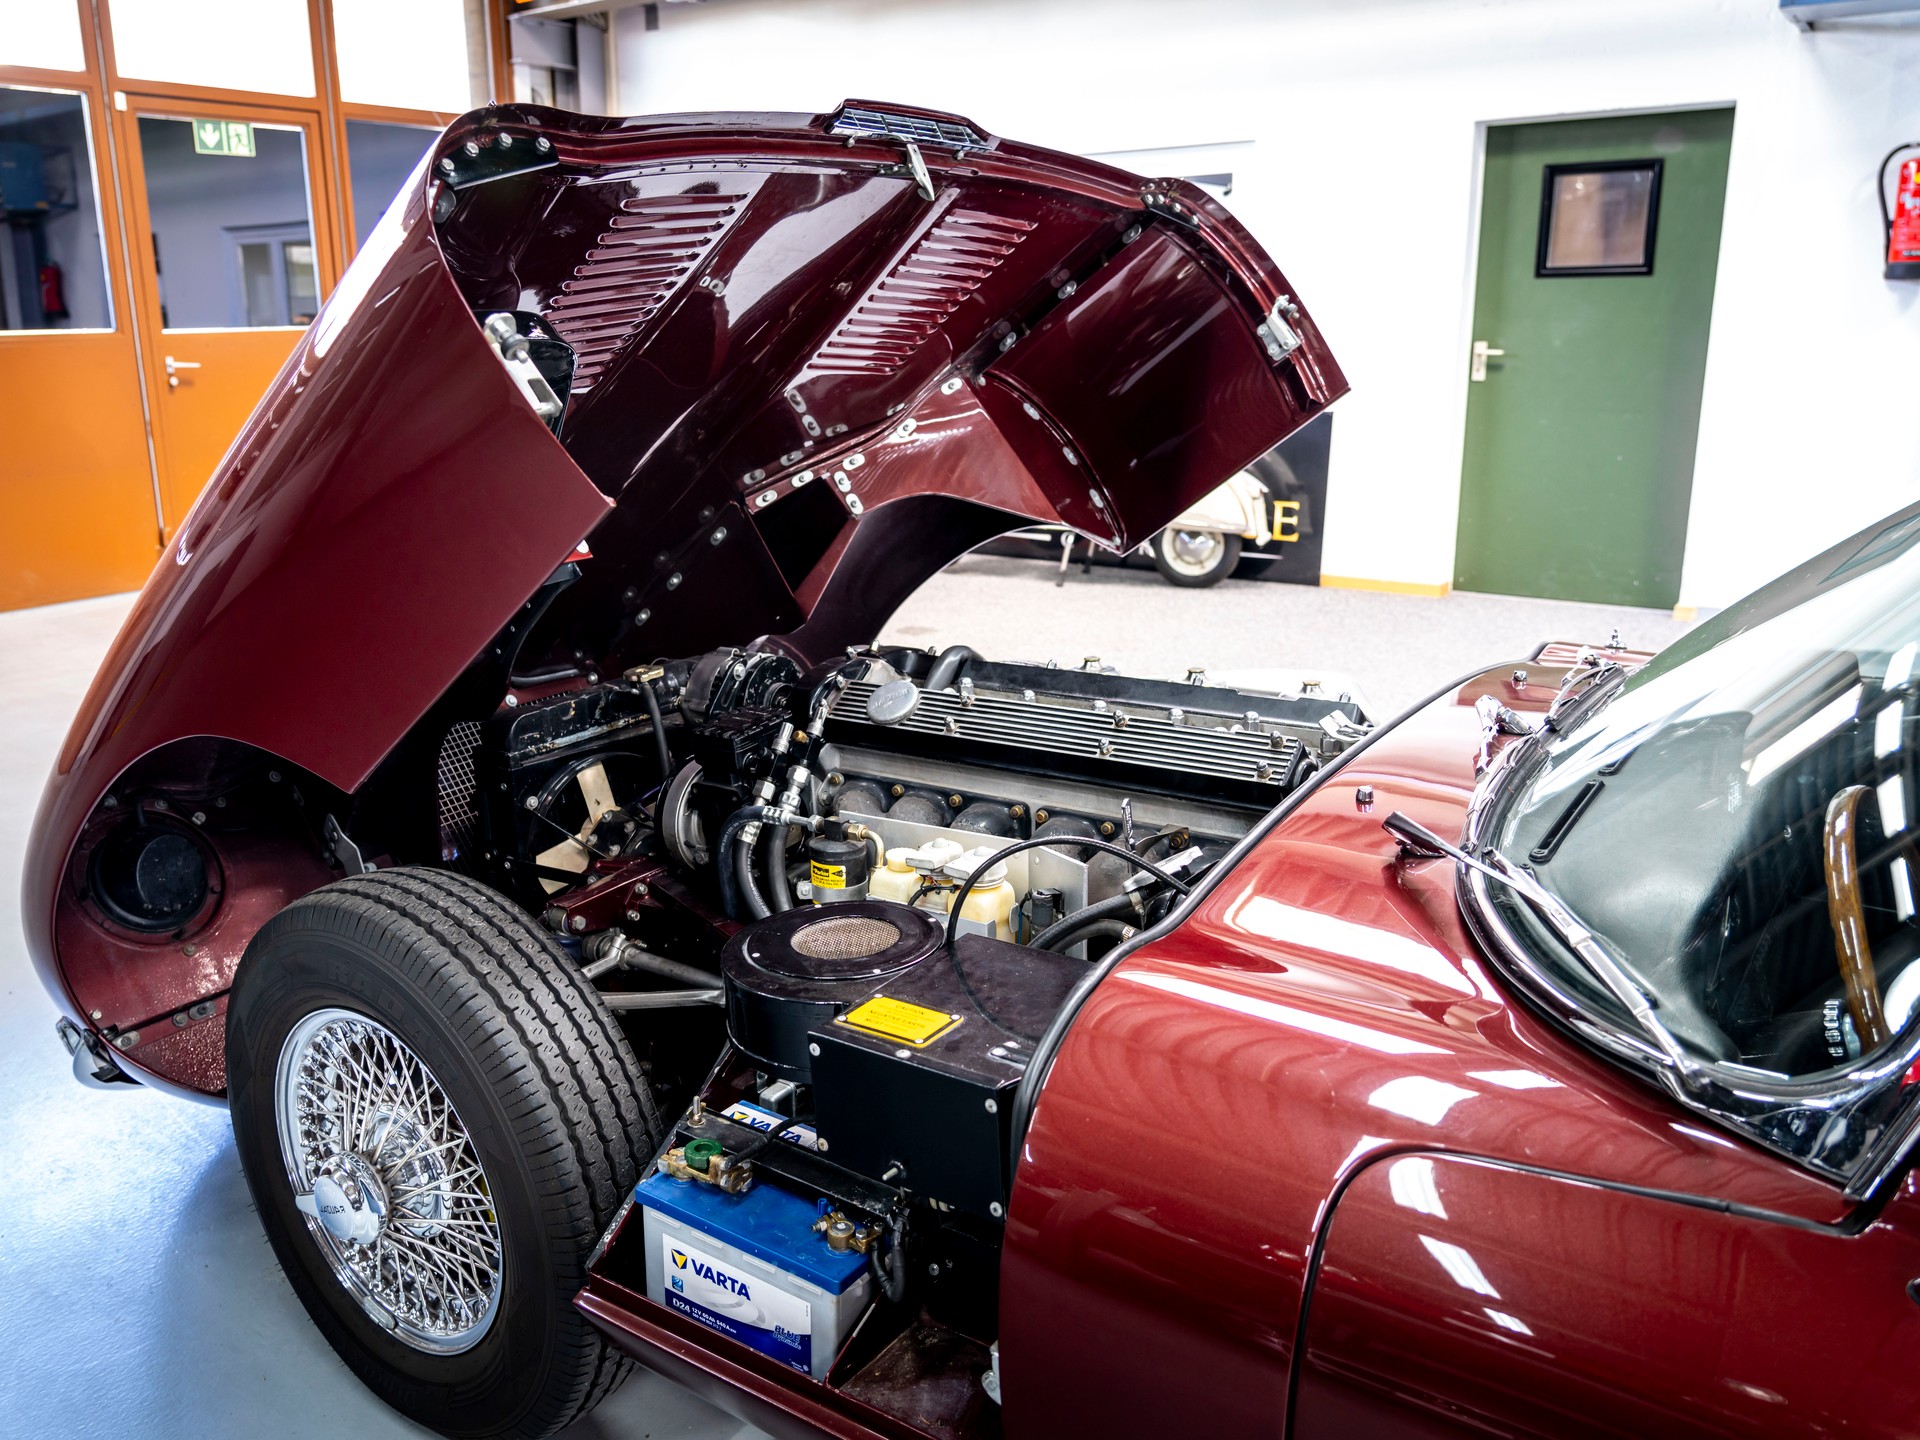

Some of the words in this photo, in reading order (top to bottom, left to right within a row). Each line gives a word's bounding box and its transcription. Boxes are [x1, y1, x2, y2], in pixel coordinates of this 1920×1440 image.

[749, 1118, 802, 1143] VATA
[320, 1205, 346, 1215] JAGUAR
[691, 1258, 751, 1301] VARTA
[672, 1297, 691, 1313] D24
[691, 1307, 702, 1316] 12V
[774, 1324, 801, 1343] BLUE
